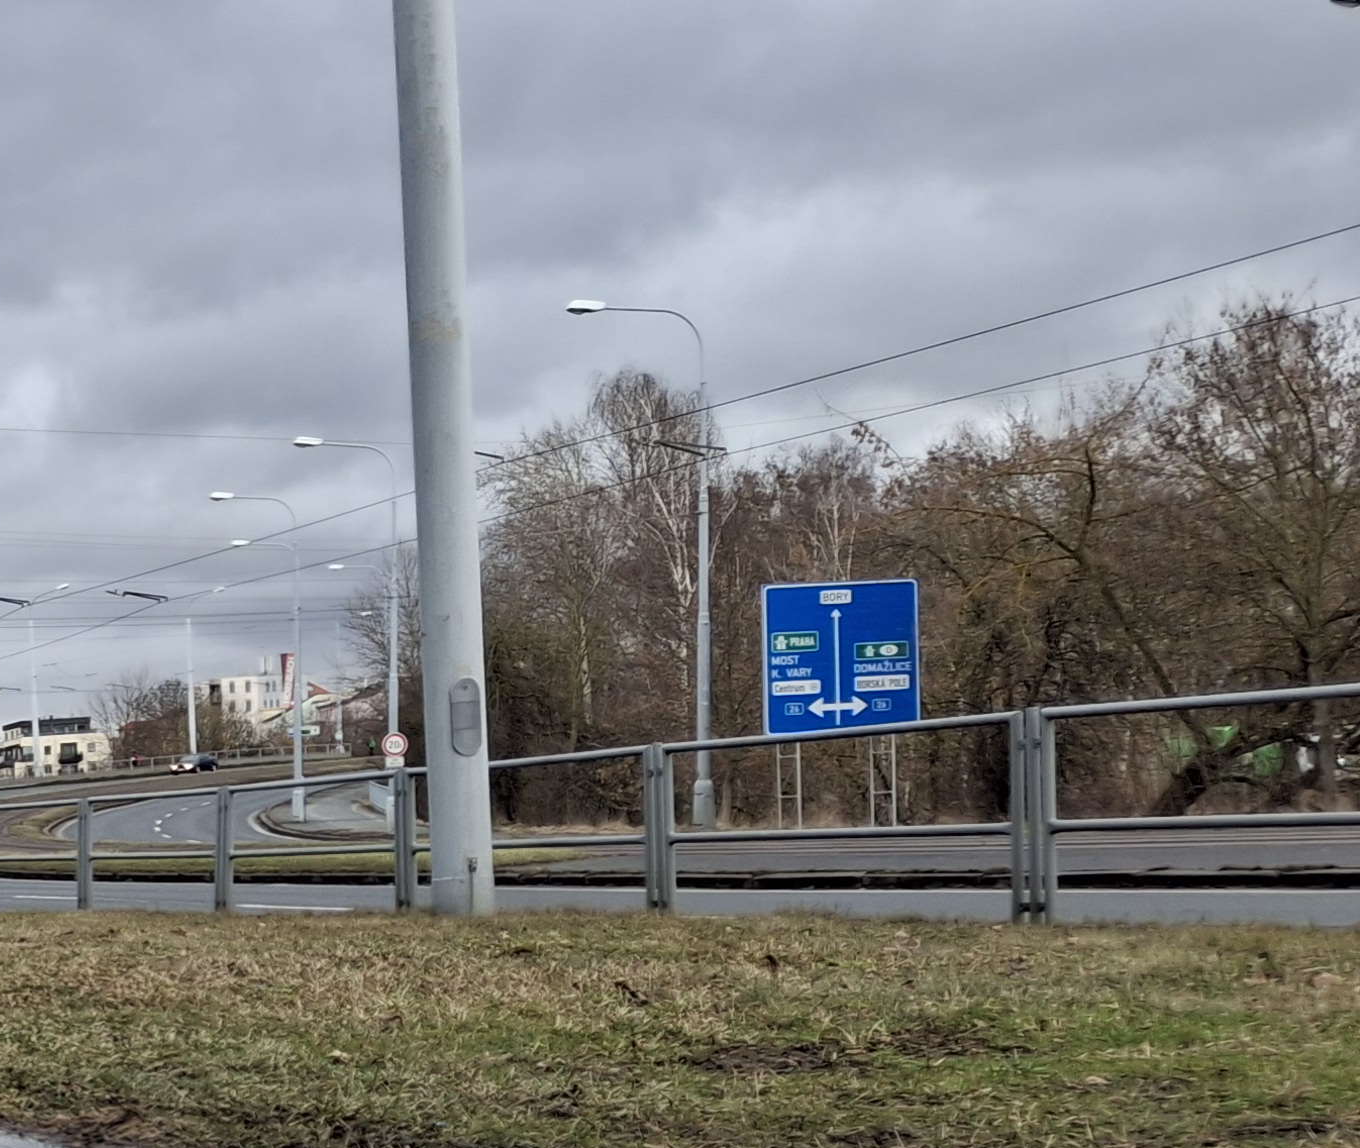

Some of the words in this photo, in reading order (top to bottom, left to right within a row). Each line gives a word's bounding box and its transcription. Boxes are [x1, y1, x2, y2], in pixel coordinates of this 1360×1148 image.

[823, 592, 848, 602] BORY
[789, 637, 815, 646] PRAHA
[771, 656, 799, 665] MOST
[854, 661, 912, 673] DOMAŽLICE
[771, 669, 782, 678] K.
[786, 668, 812, 677] VARY
[857, 677, 885, 690] BORSKÁ
[890, 677, 907, 688] POLE
[774, 684, 806, 693] Centrum
[876, 700, 887, 709] 26
[788, 705, 800, 714] 26
